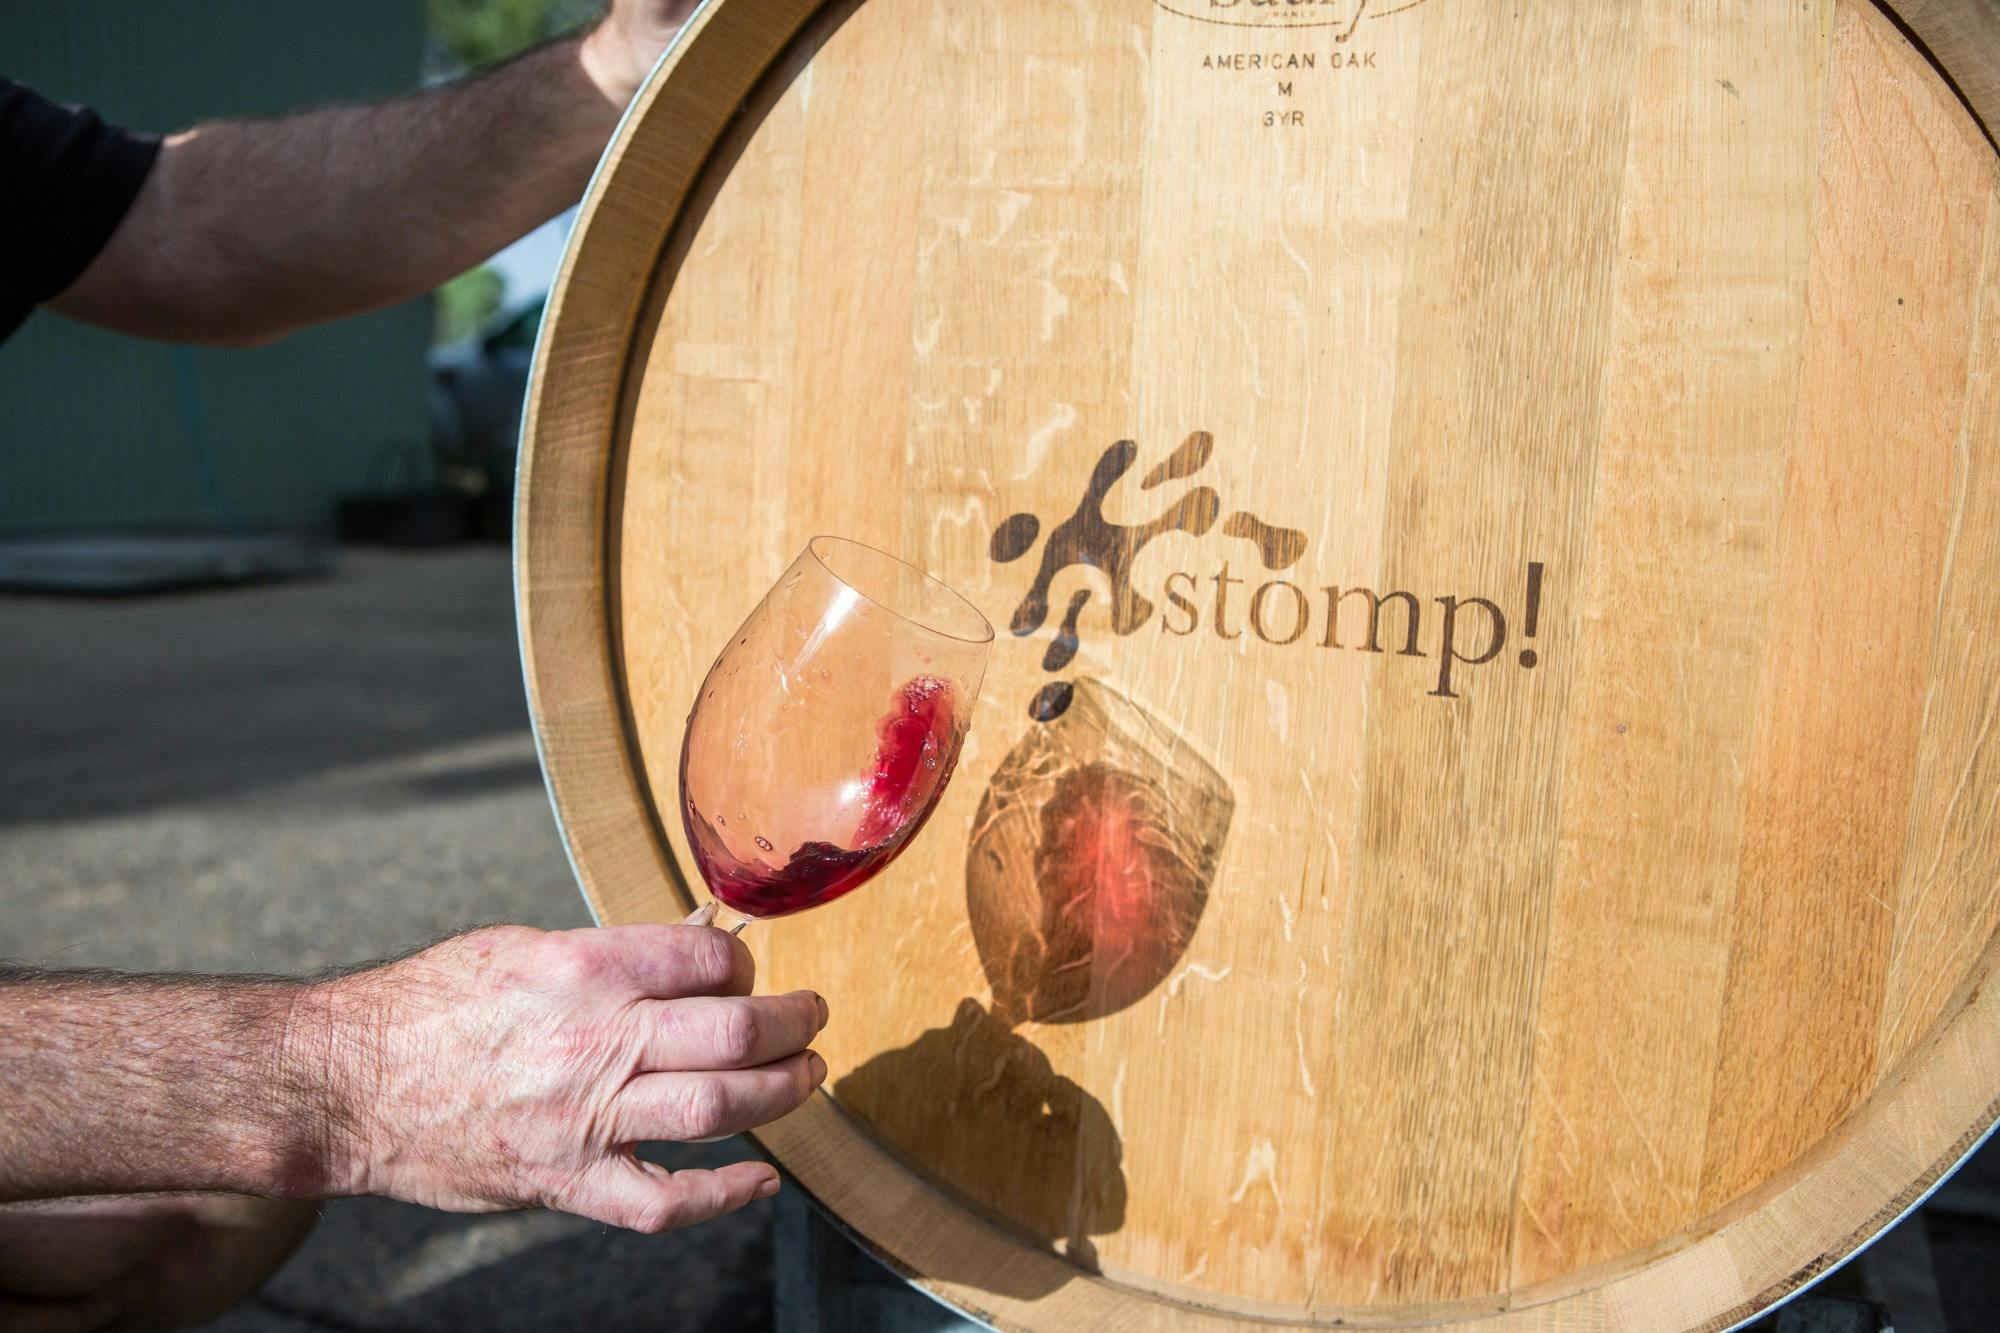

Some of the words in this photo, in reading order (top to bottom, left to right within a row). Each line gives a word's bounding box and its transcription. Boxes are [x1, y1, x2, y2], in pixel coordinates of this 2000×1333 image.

[1202, 53, 1316, 70] AMERICAN
[1330, 52, 1377, 70] OAK
[1277, 81, 1293, 97] M
[1263, 110, 1306, 127] 3YR
[1160, 560, 1544, 699] stomp!
